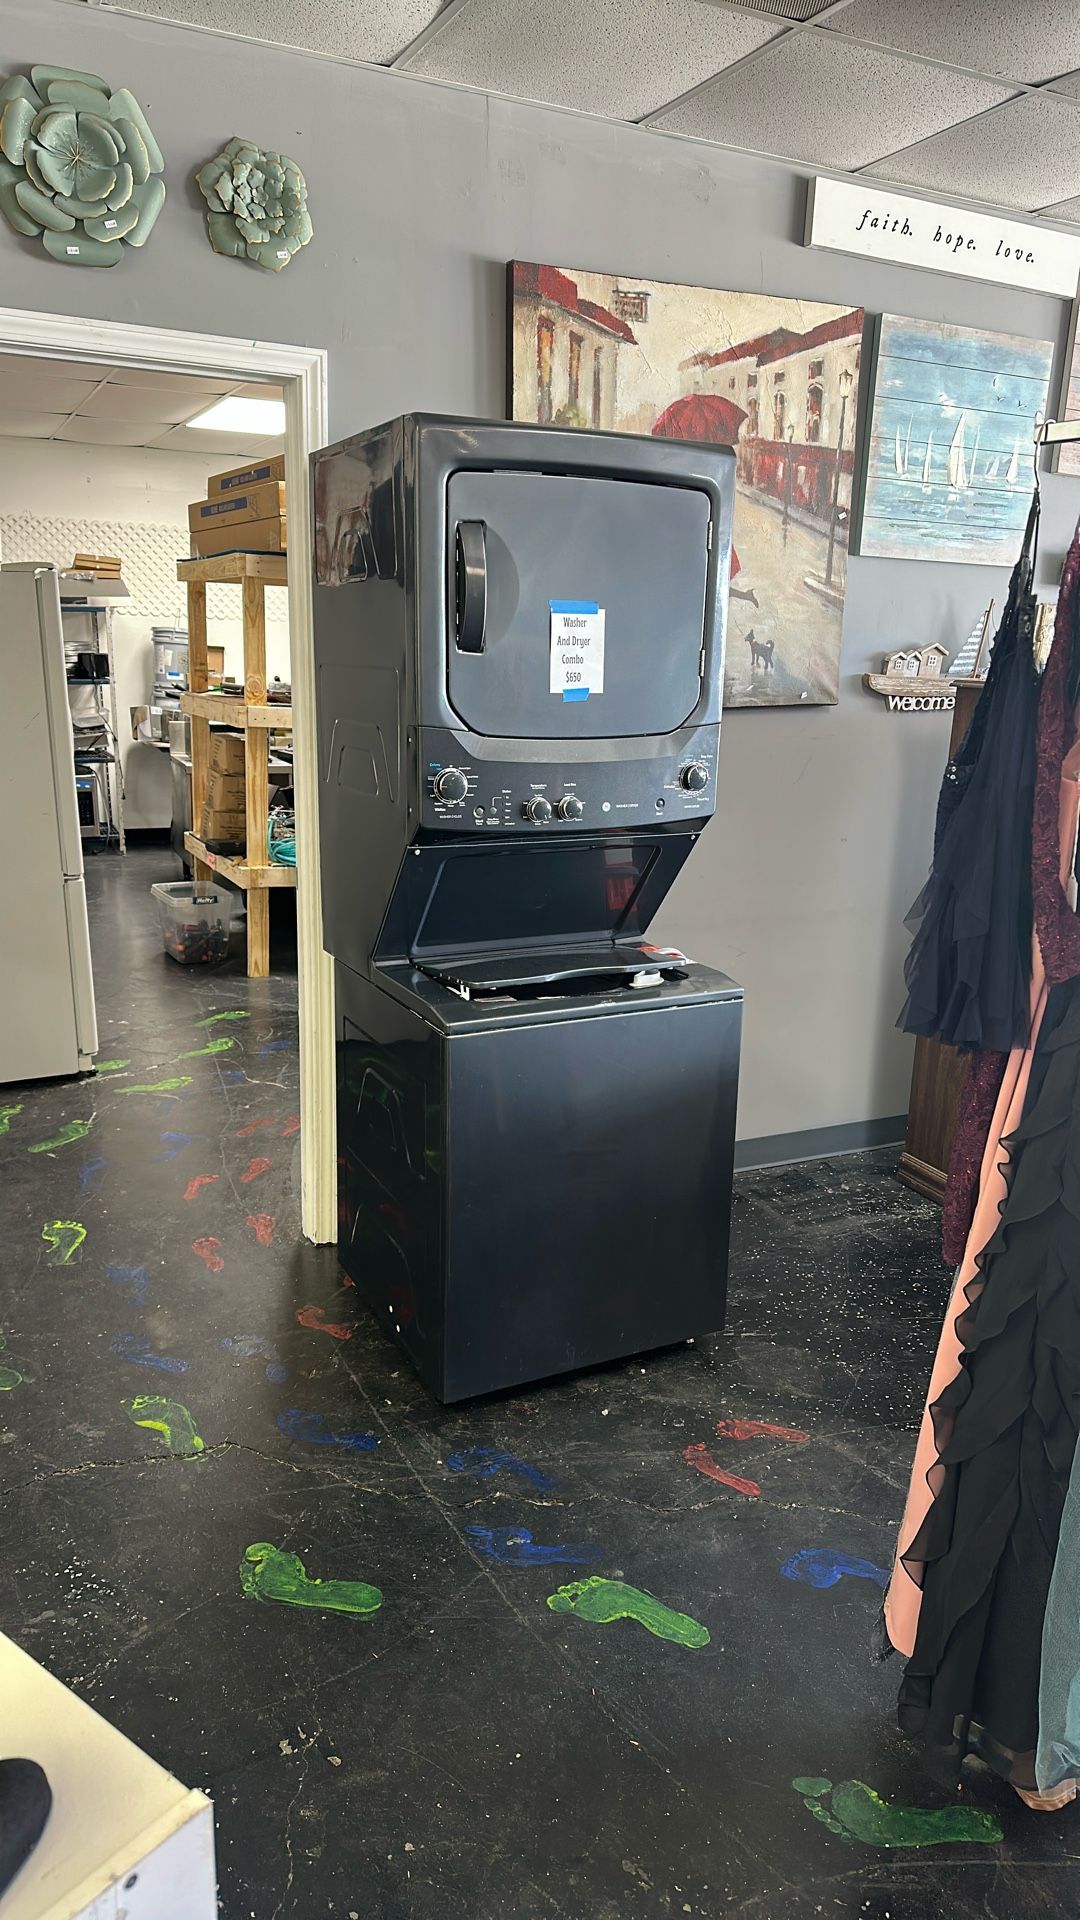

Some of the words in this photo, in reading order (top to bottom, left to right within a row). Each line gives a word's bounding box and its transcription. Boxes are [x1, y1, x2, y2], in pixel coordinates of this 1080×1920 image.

[855, 210, 913, 236] faith.
[933, 225, 976, 253] hope.
[995, 240, 1035, 263] love.
[563, 617, 587, 628] Washer
[557, 635, 571, 646] And
[572, 635, 590, 648] Dryer
[561, 654, 584, 664] Combo
[565, 671, 582, 683] $650
